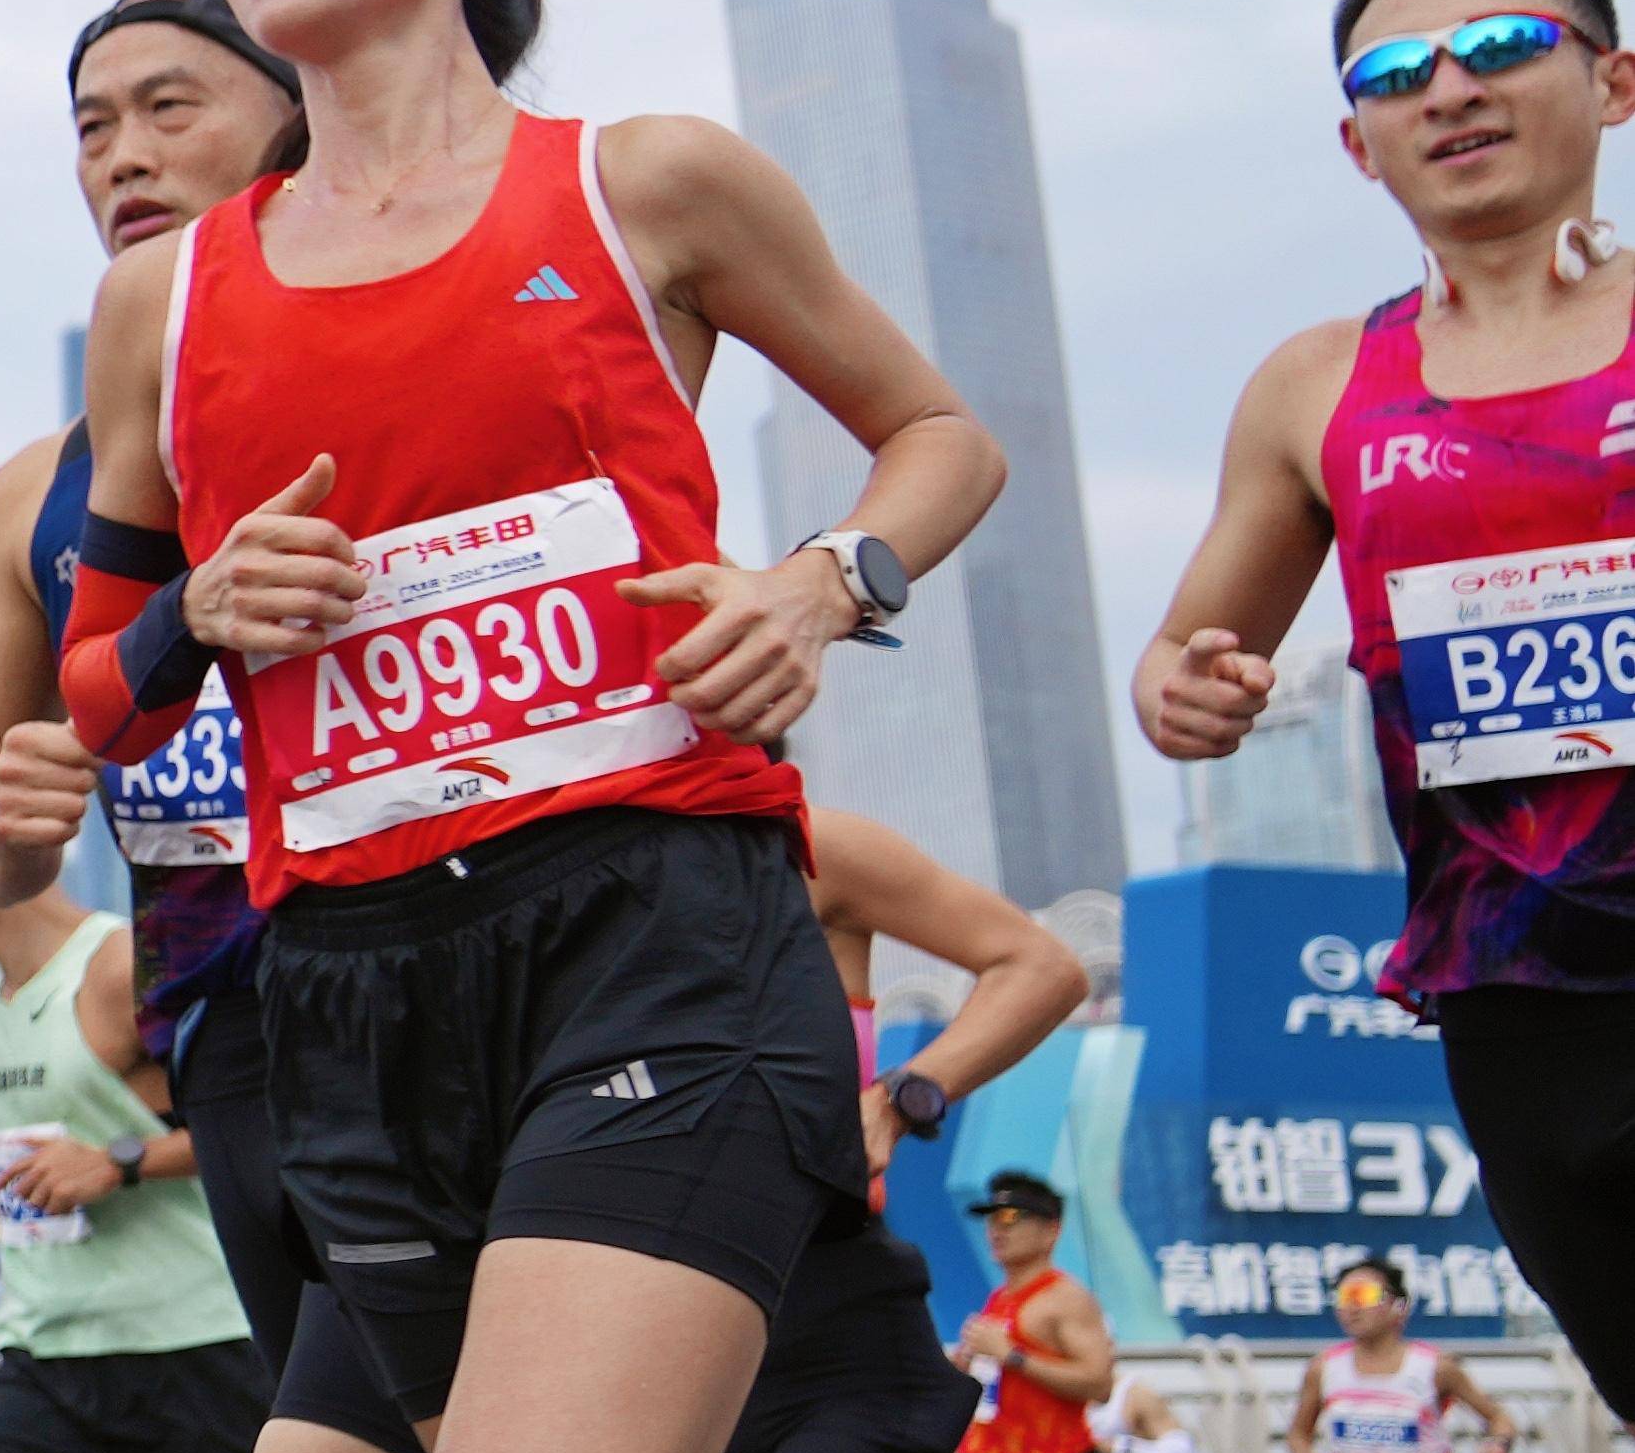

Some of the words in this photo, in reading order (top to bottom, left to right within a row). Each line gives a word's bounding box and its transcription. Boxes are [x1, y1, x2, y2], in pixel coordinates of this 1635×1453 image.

[381, 513, 534, 575] 广汽丰田
[1529, 552, 1635, 586] 广汽丰
[312, 585, 598, 756] A9930
[1446, 615, 1635, 715] B236
[441, 777, 482, 804] ANTA
[1284, 993, 1441, 1041] 广汽丰
